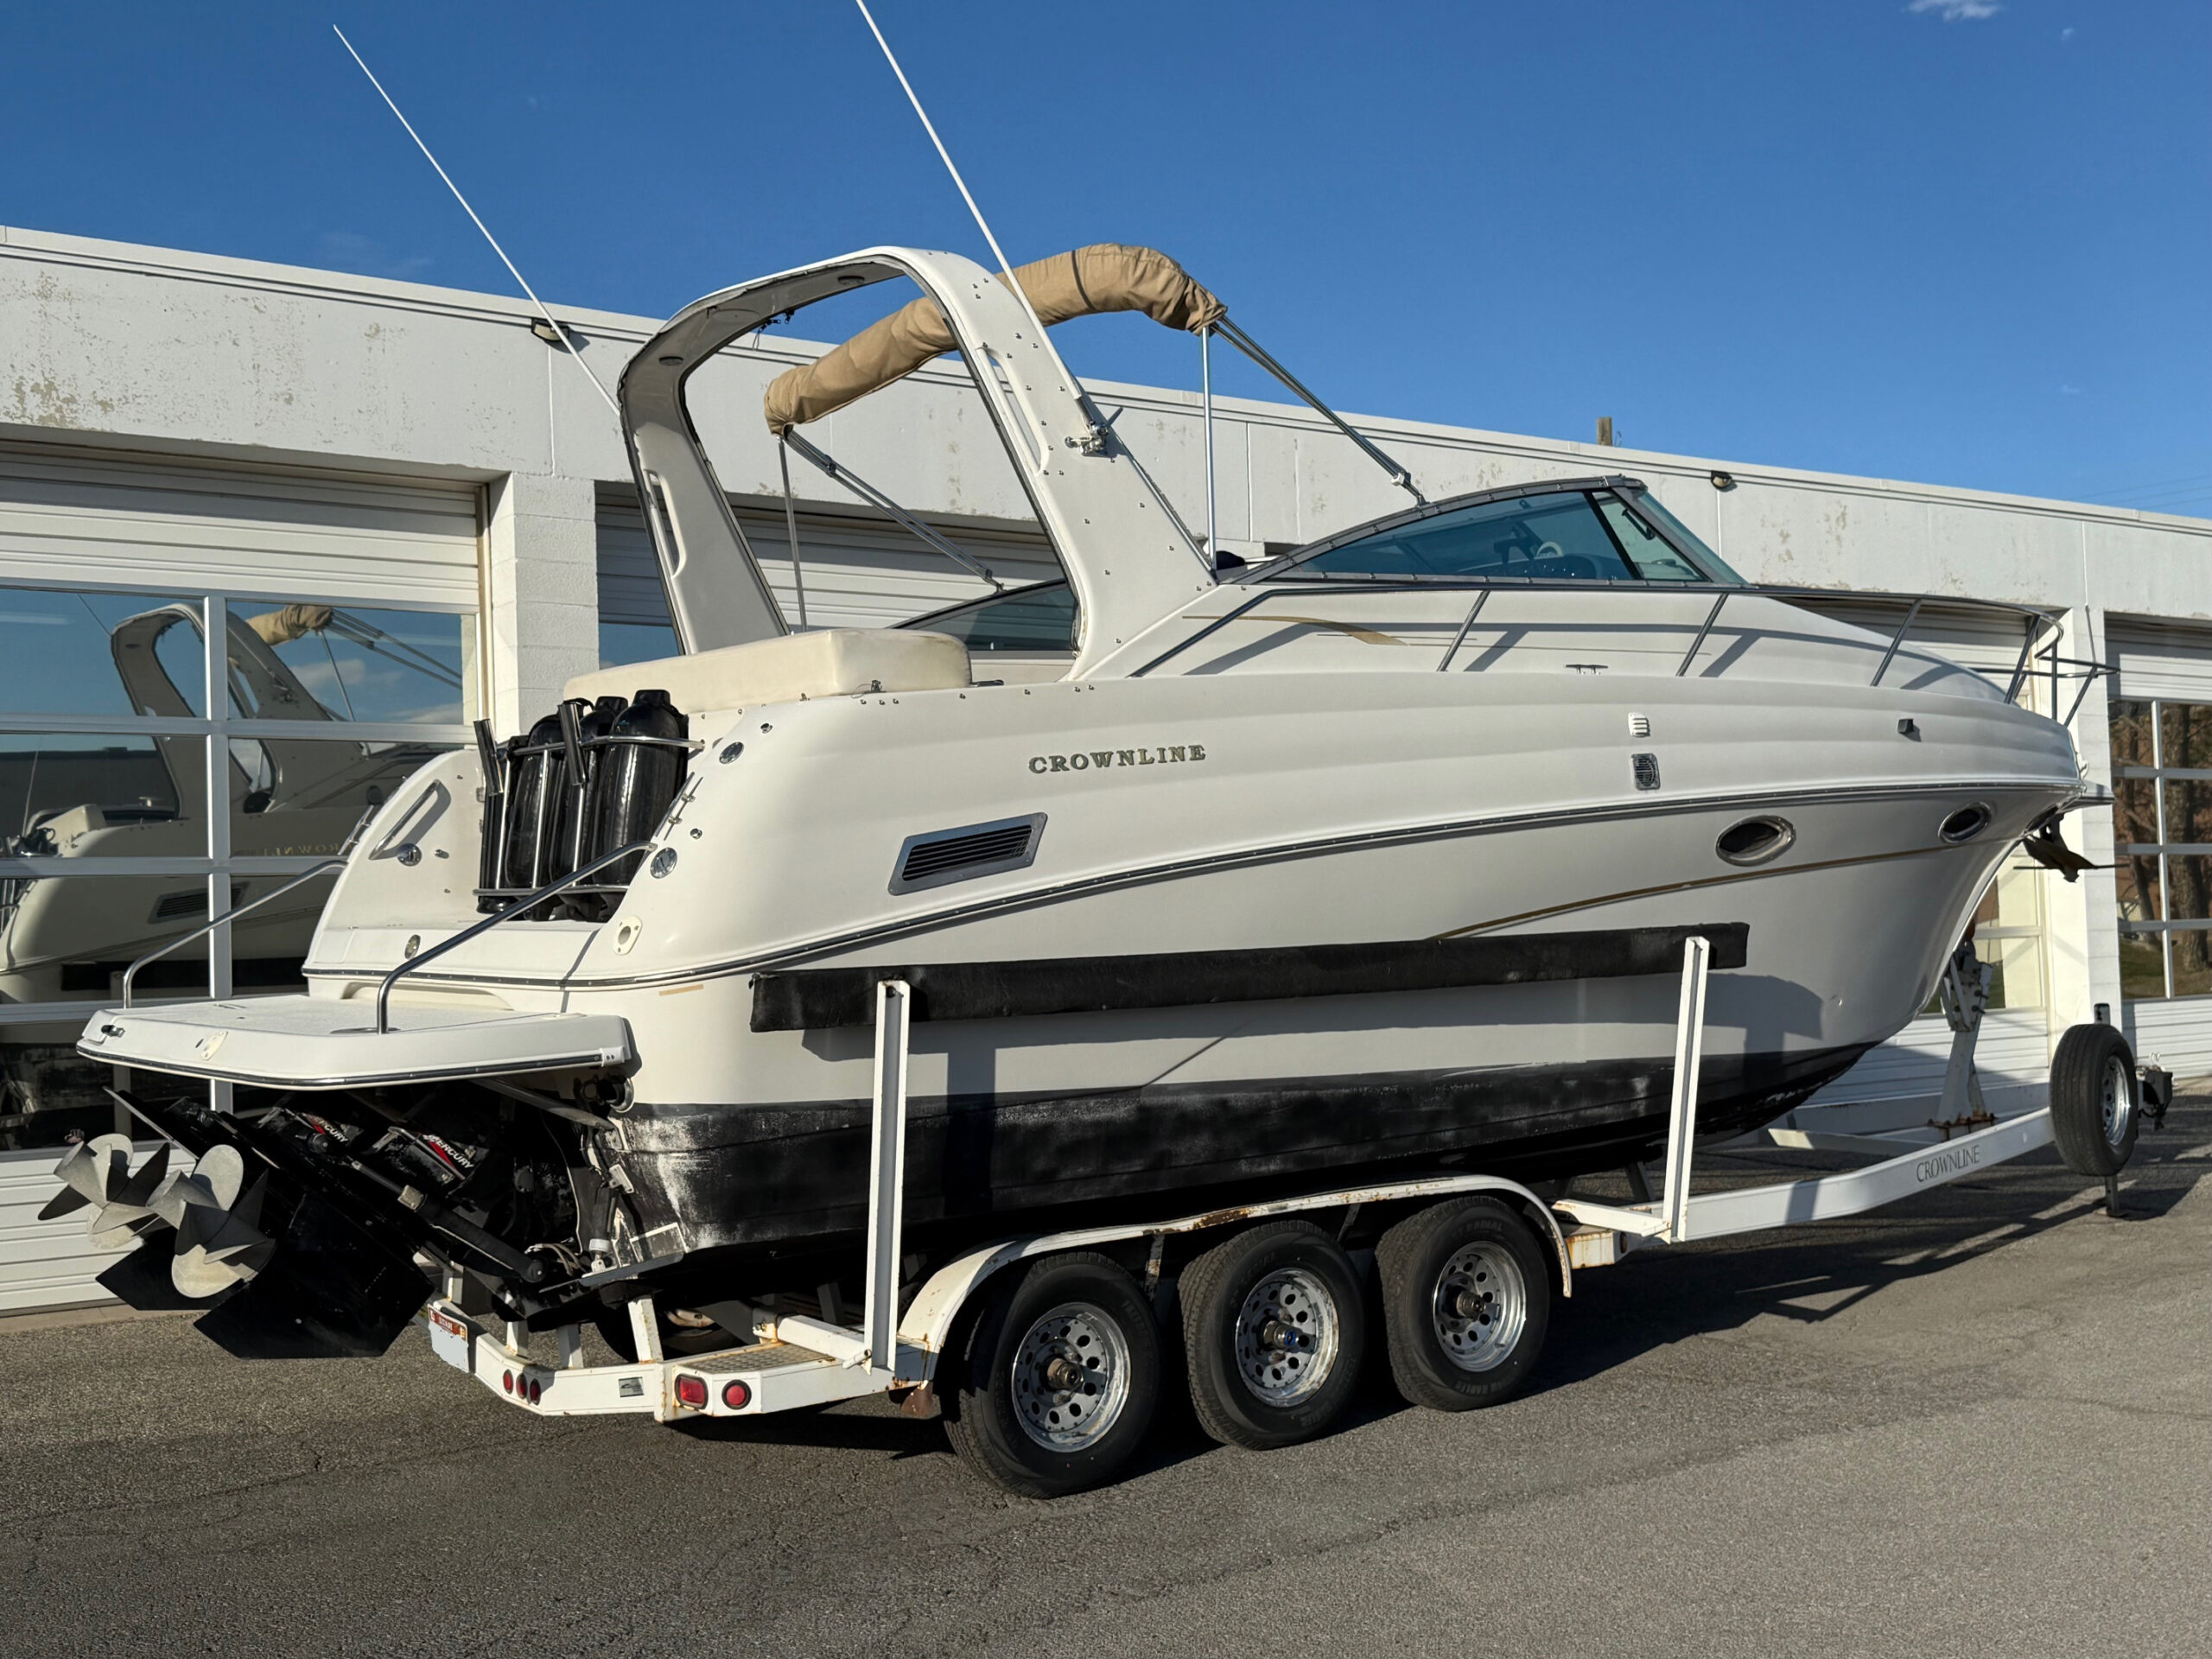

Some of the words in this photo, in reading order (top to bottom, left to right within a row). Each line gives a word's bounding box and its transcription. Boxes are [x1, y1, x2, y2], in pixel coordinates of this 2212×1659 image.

[1028, 744, 1207, 774] CROWNLINE
[423, 1134, 474, 1168] MERCURY
[1916, 1144, 1980, 1183] CROWNLINE
